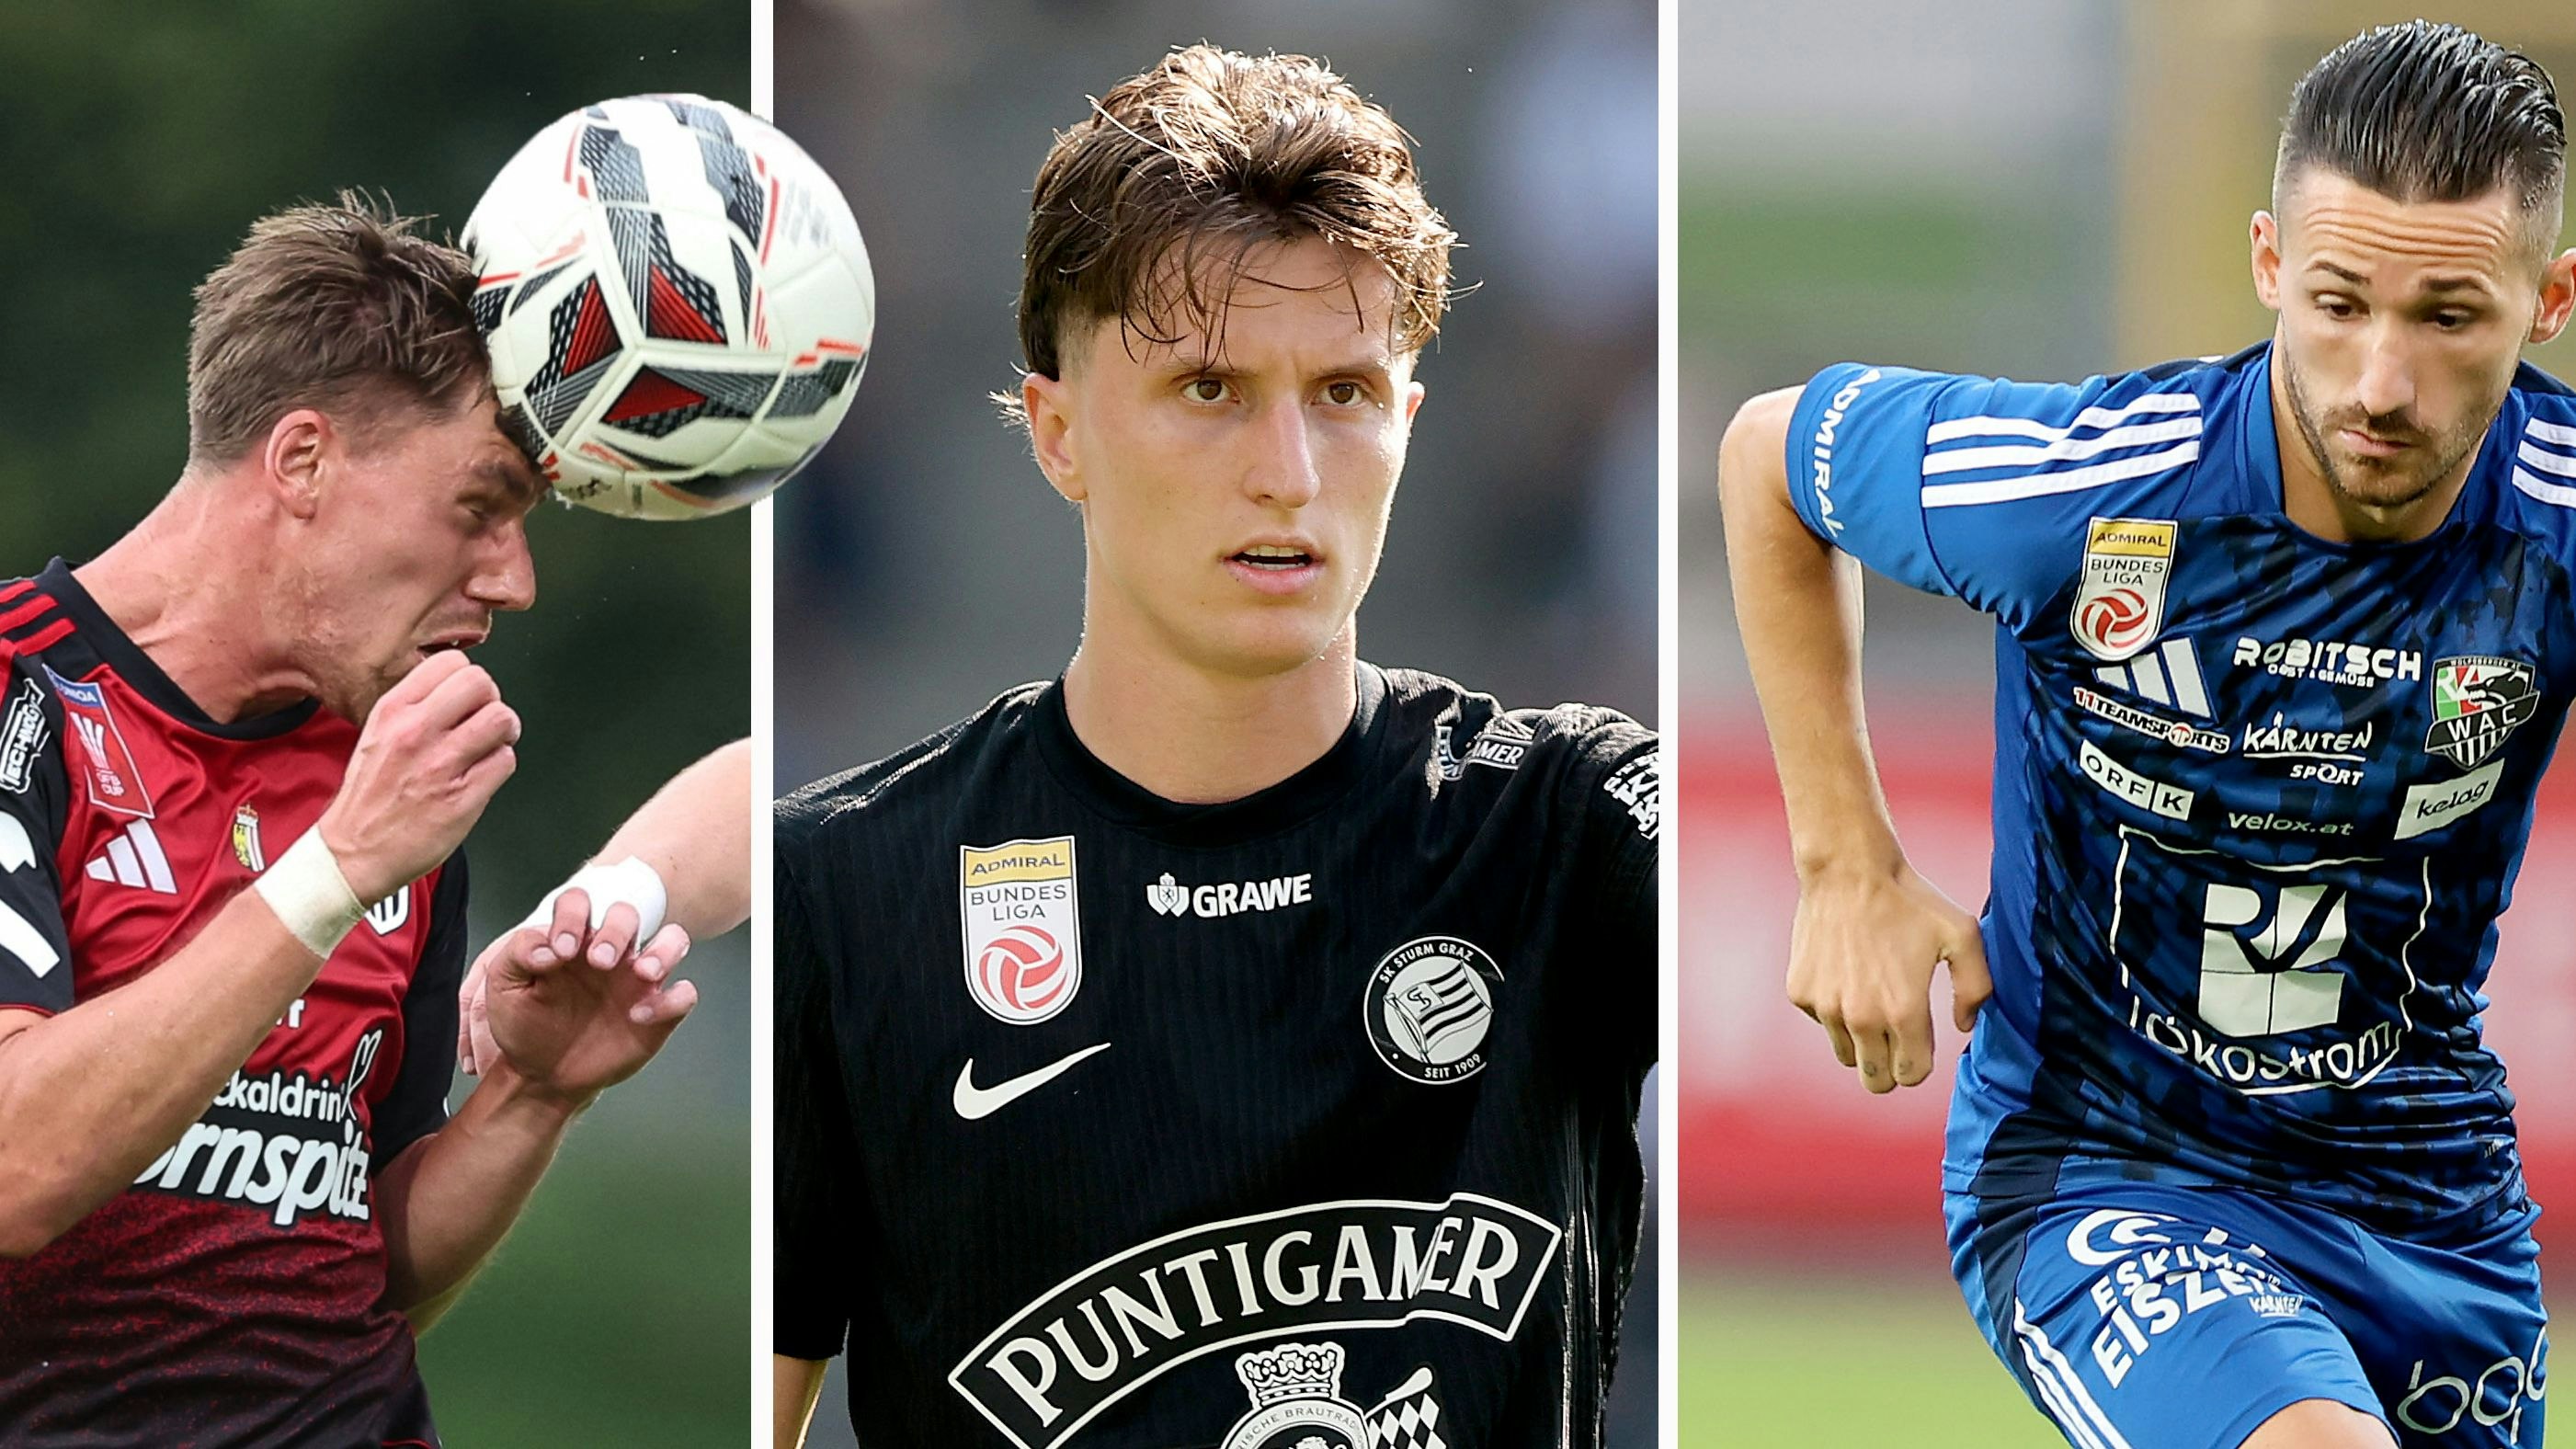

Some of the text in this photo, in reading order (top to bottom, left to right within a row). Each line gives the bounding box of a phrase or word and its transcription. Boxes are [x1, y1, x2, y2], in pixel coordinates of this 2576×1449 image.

[1814, 369, 1881, 538] ADMIRAL
[2096, 532, 2167, 547] ADMIRAL
[2091, 559, 2164, 574] BUNDES
[2103, 573, 2144, 586] LIGA
[2233, 636, 2422, 681] ROBITSCH
[2243, 711, 2373, 752] KÄRNTEN
[2290, 763, 2364, 785] SPORT
[2417, 781, 2490, 819] kelag
[2228, 813, 2354, 836] velox.at
[972, 853, 1065, 875] ADMIRAL
[971, 885, 1066, 906] BUNDES
[1194, 873, 1312, 918] GRAWE
[993, 904, 1045, 921] LIGA
[1380, 943, 1474, 984] SK STURM GRAZ
[1424, 1054, 1482, 1078] SEIT 1909
[986, 1216, 1519, 1429] PUNTIGAMER
